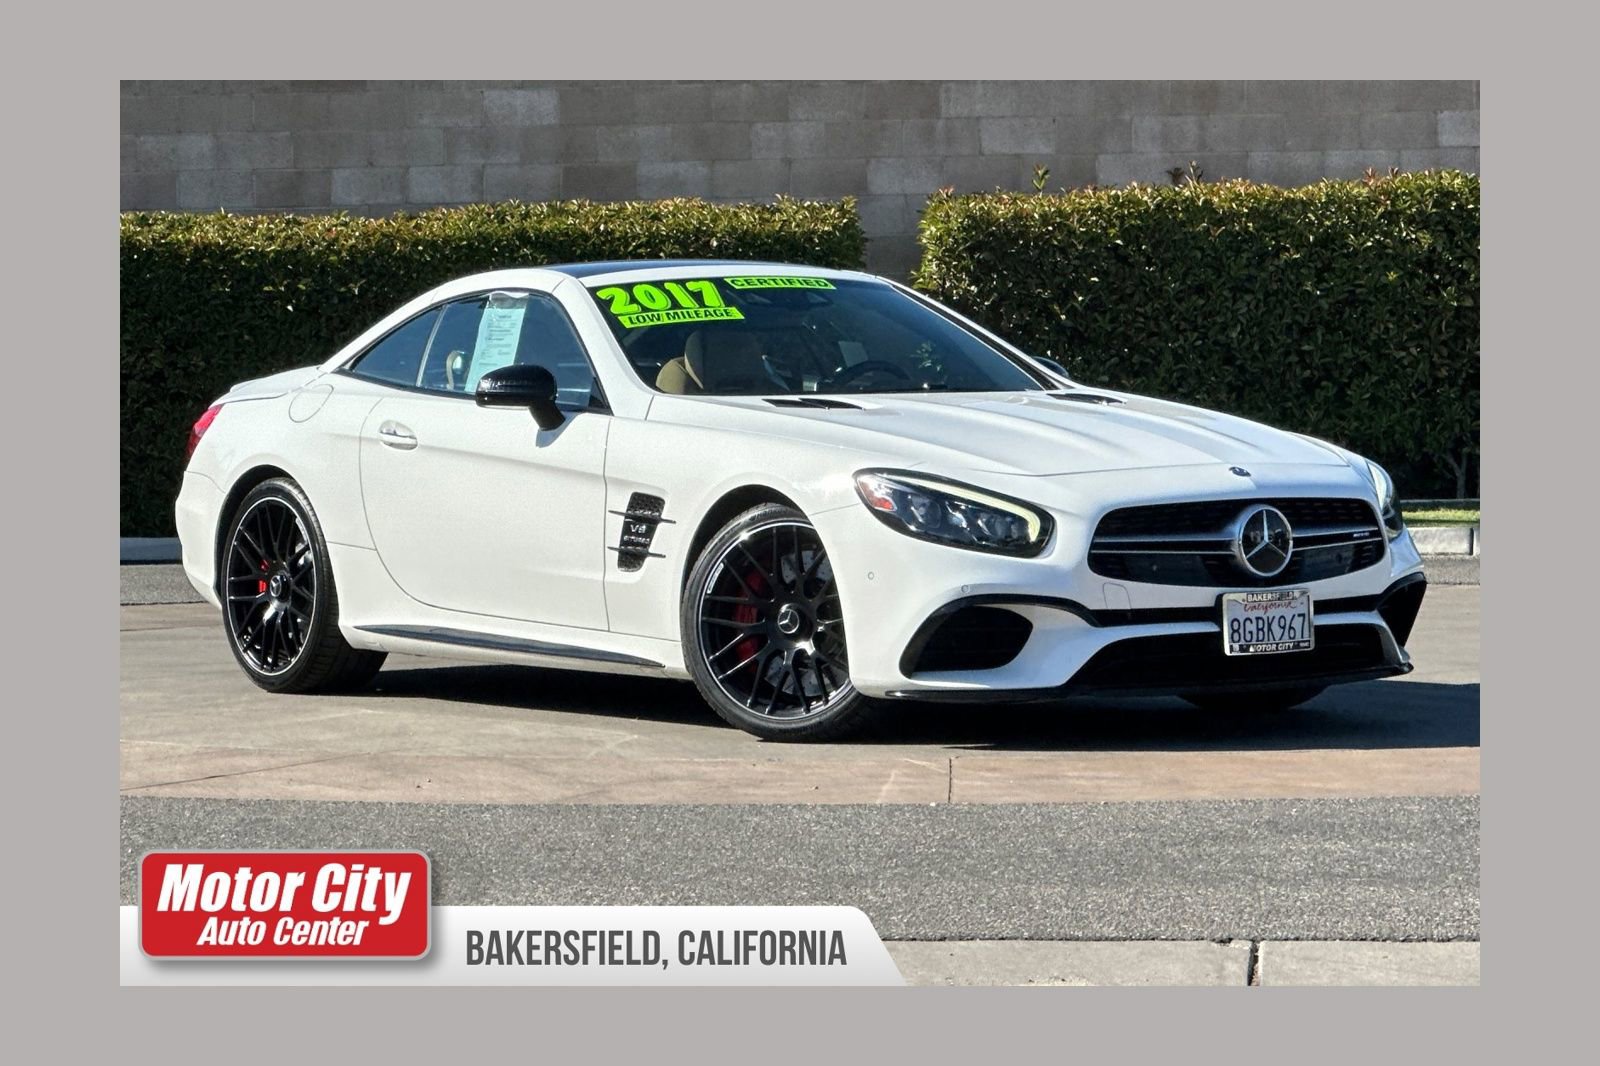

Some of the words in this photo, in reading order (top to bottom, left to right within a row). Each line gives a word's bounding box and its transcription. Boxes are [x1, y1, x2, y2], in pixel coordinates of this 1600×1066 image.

[730, 278, 829, 288] CERTIFIED
[596, 280, 725, 315] 2017
[628, 312, 662, 325] LOW
[666, 308, 732, 322] MILEAGE
[1230, 613, 1306, 643] 8GBK967
[1277, 642, 1294, 651] CITY
